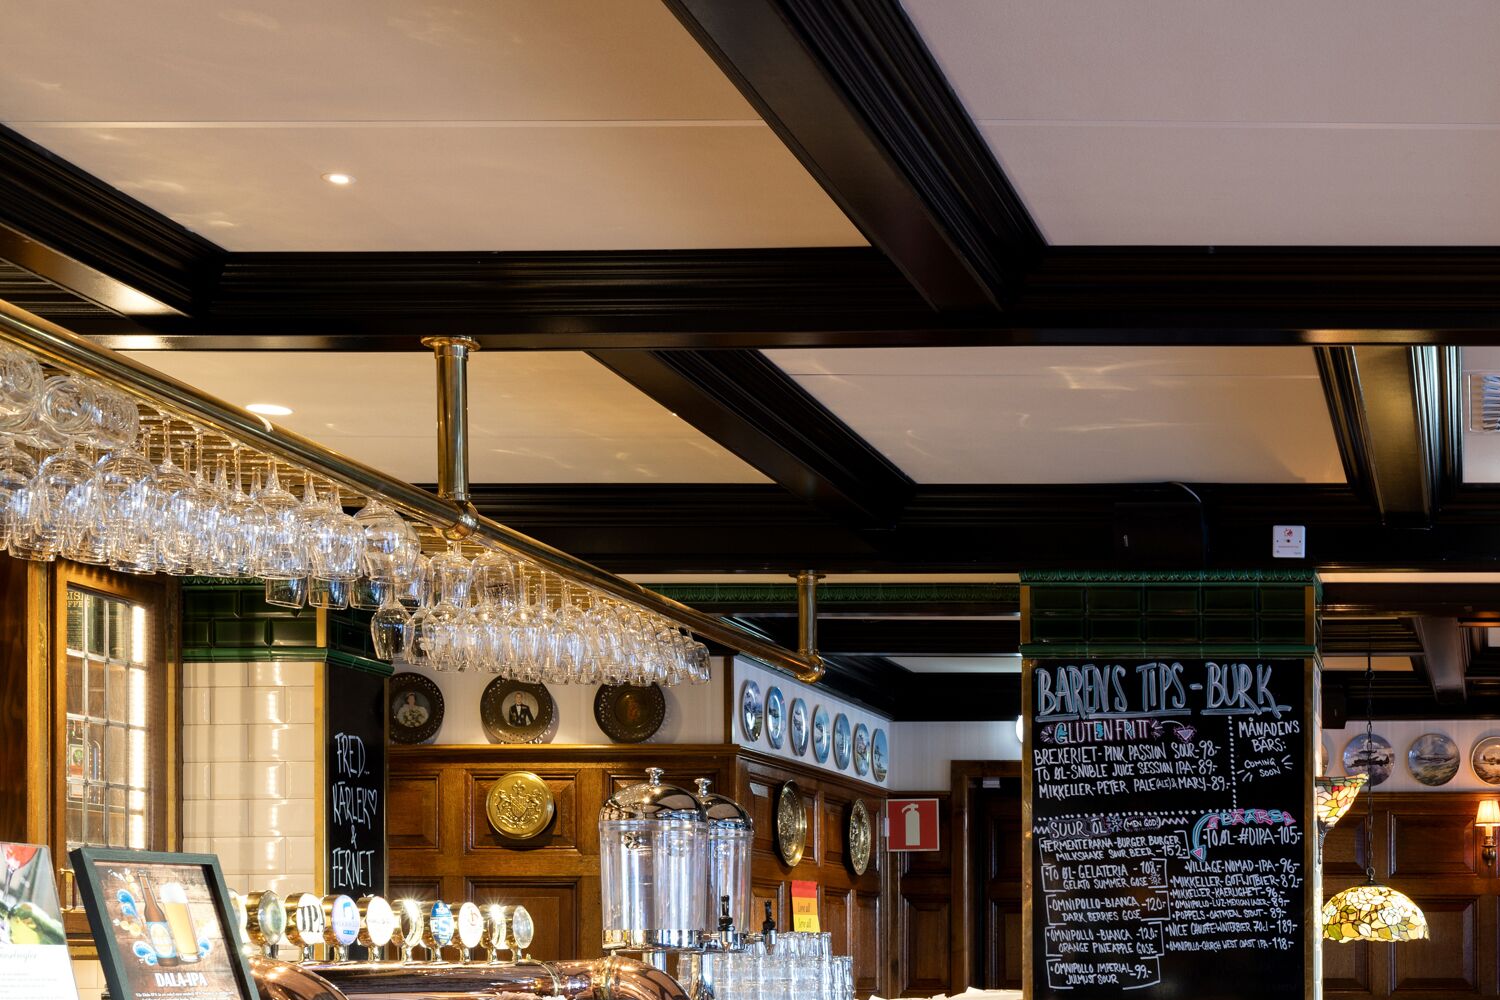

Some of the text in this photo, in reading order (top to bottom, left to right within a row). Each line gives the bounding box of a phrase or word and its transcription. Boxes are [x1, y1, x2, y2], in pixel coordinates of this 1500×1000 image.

[1136, 662, 1186, 712] TIPS
[1205, 662, 1282, 719] BURK
[1239, 717, 1300, 738] MÅNADENS
[1128, 742, 1167, 761] PASSION
[1244, 758, 1277, 769] COMING
[1034, 766, 1050, 783] TO
[1112, 763, 1135, 776] JUICE
[1137, 761, 1173, 774] SESSION
[1260, 766, 1281, 777] SOON
[1050, 817, 1107, 839] SUUR ÖL
[350, 825, 357, 849] &
[1147, 835, 1181, 846] BURGER
[1056, 850, 1105, 862] MILKSHAKE
[1108, 849, 1130, 859] SOUR
[1129, 847, 1156, 857] BEER
[332, 848, 375, 889] FERNET
[1046, 865, 1059, 880] TO
[1063, 876, 1149, 890] GELATO SUMMER GOSE
[1062, 909, 1142, 923] DARK BERRIES GOSE
[1168, 922, 1188, 937] NICE
[1058, 942, 1157, 955] ORANGE PINEAPPLE GOSE
[1221, 939, 1238, 949] WEST
[1054, 963, 1094, 975] OMNIPOLLO
[1097, 962, 1134, 973] IMPERIAL
[154, 972, 208, 988] DALA-IPA
[1097, 974, 1119, 985] SOUR
